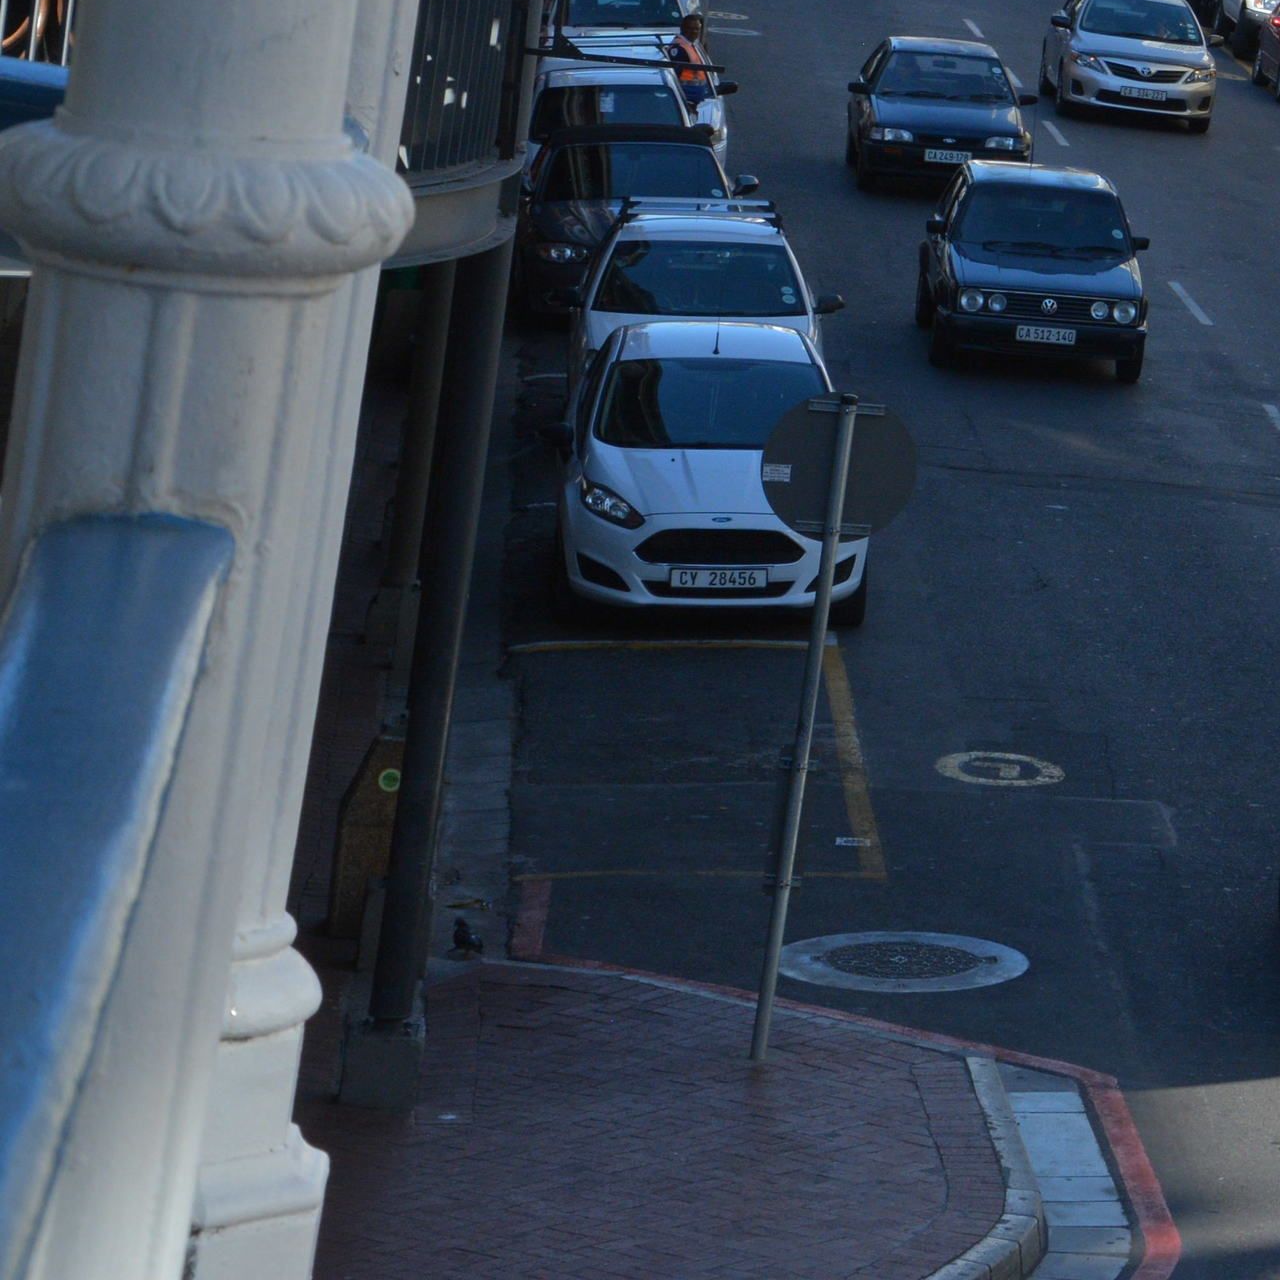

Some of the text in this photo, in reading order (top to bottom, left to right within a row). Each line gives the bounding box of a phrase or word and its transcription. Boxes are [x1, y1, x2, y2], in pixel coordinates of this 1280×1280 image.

[1018, 326, 1074, 344] CA 512-140
[679, 571, 756, 587] CY 28456
